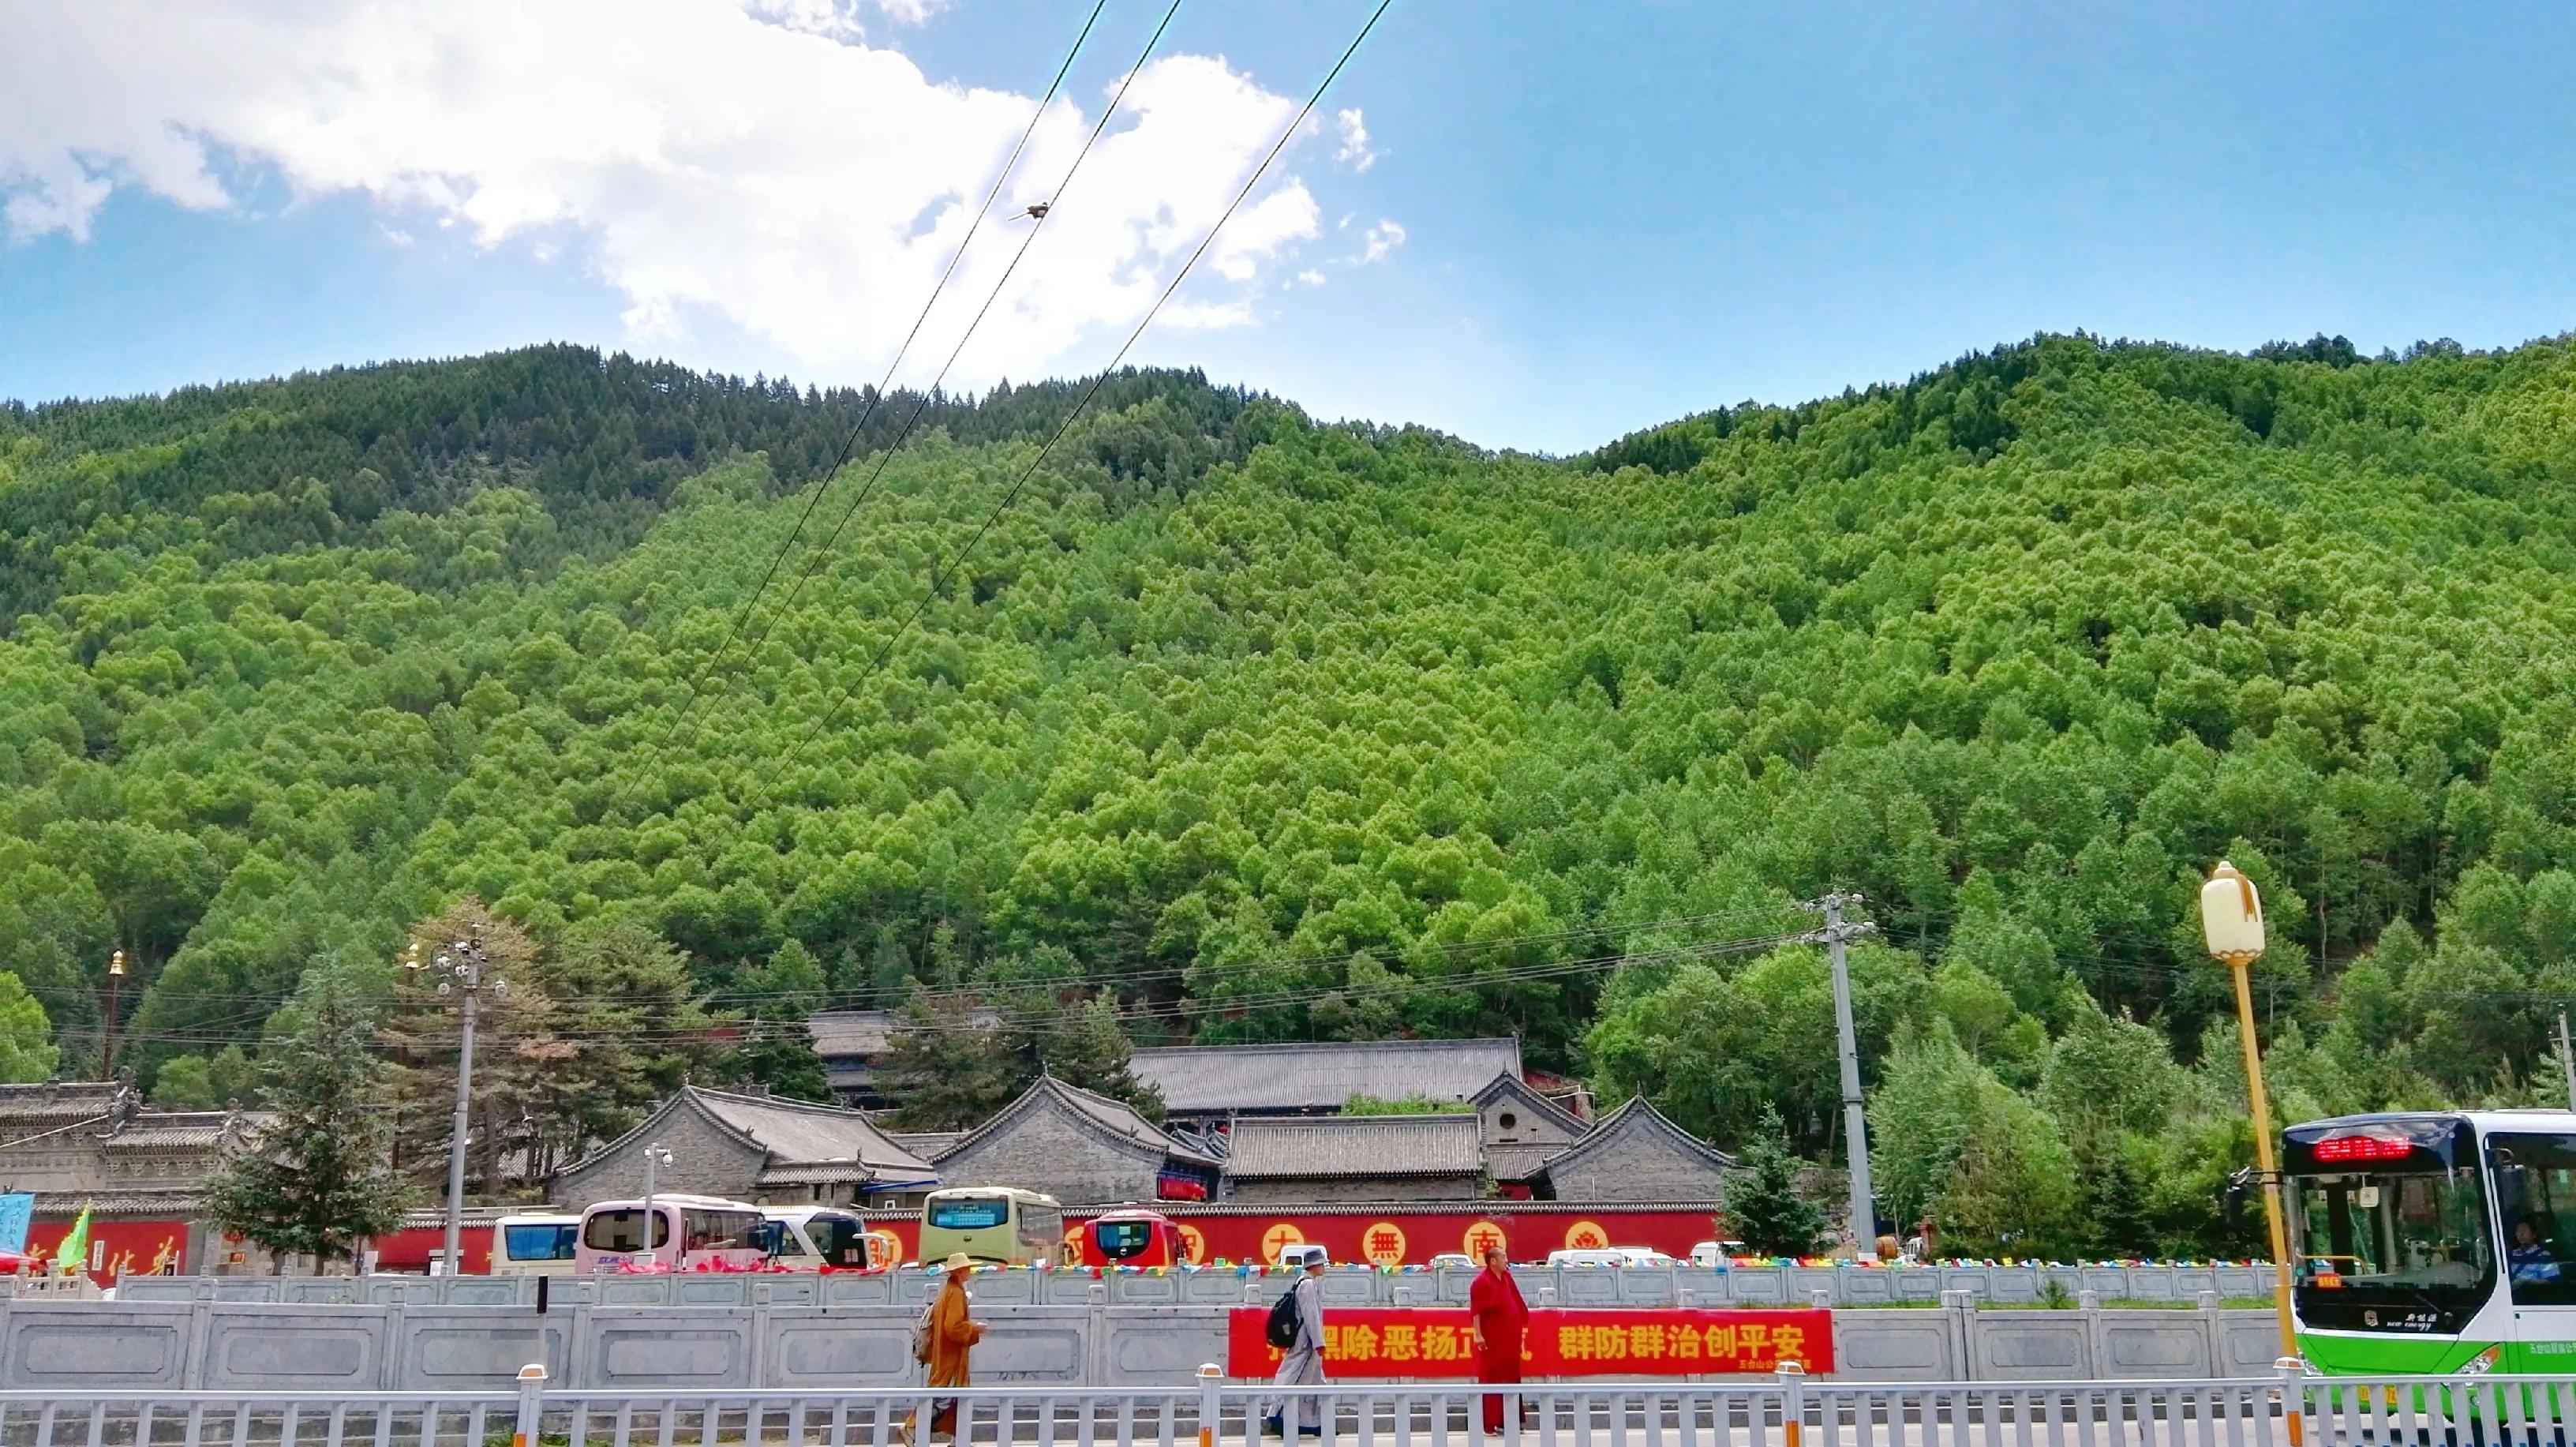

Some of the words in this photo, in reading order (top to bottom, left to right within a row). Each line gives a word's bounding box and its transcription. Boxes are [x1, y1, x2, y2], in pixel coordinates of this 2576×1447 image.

[1268, 1231, 1297, 1261] 大
[1371, 1231, 1398, 1259] 無
[1267, 1325, 1533, 1360] 黑除恶扬
[1559, 1325, 1805, 1359] 群防群治创平安
